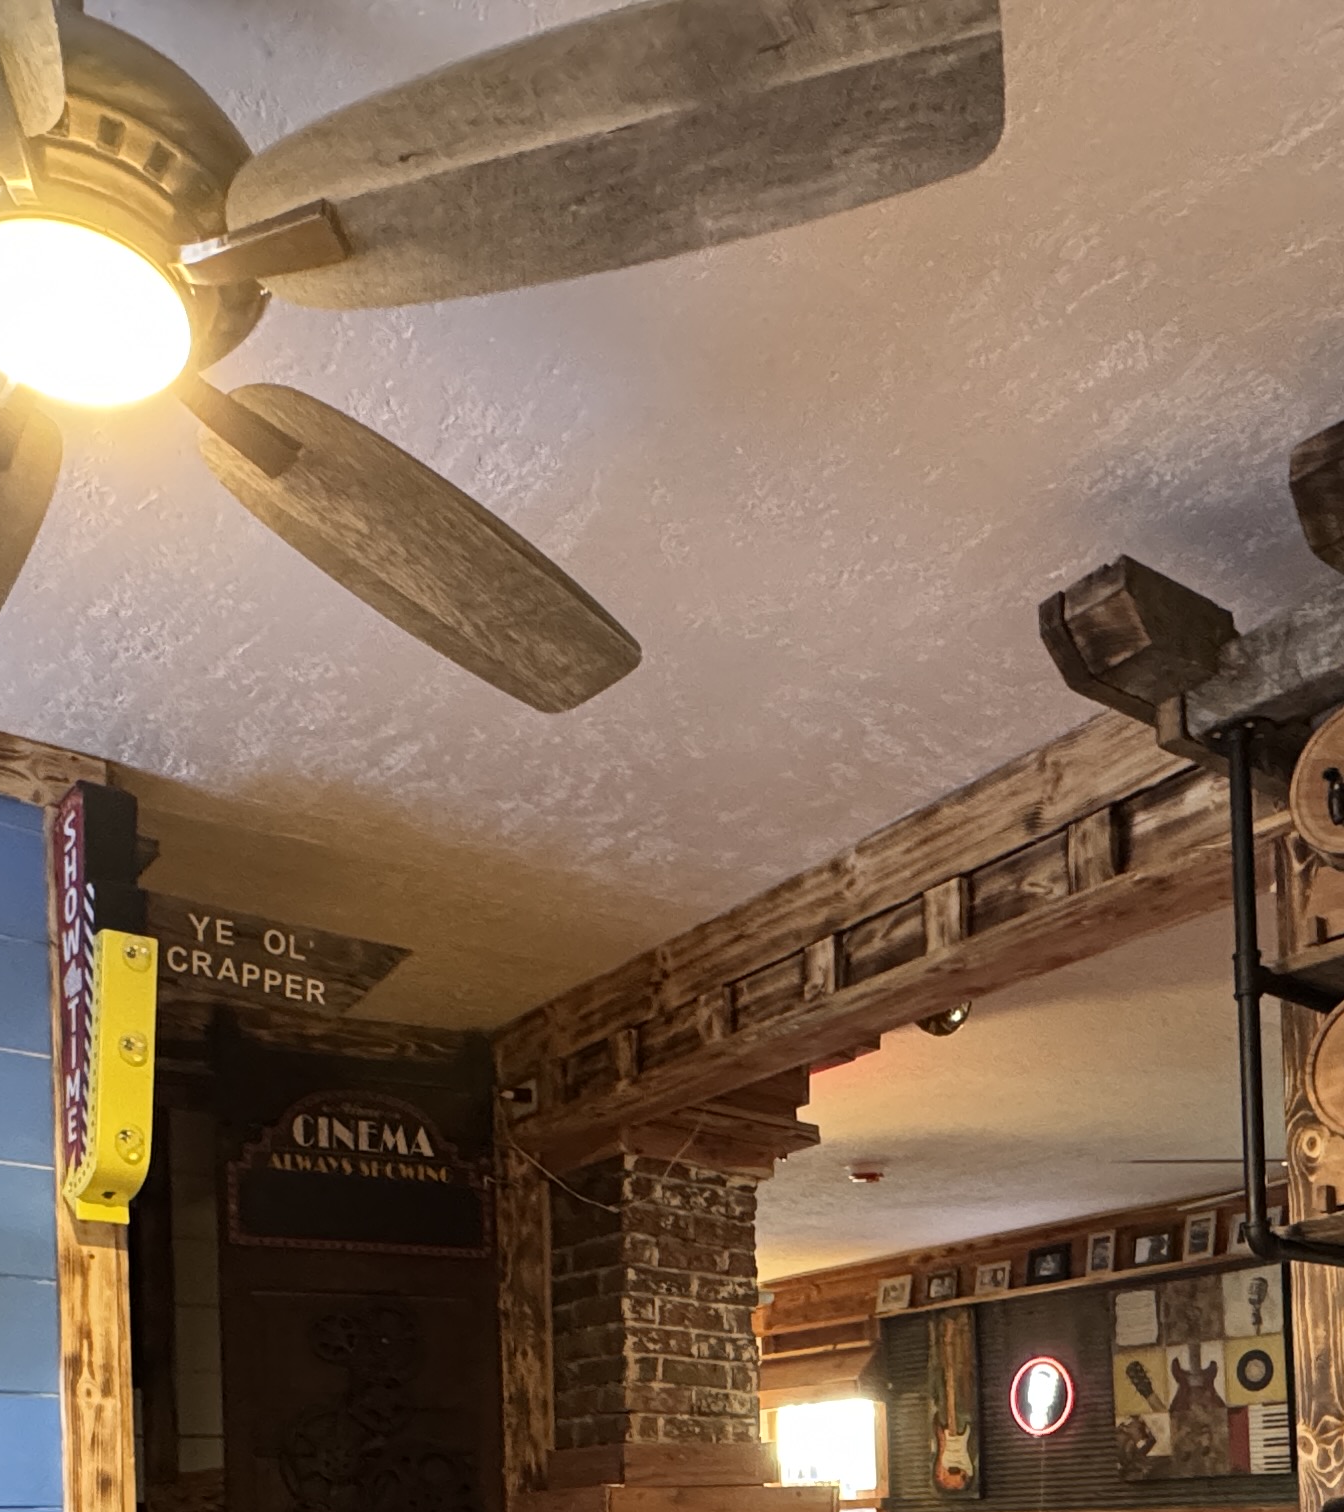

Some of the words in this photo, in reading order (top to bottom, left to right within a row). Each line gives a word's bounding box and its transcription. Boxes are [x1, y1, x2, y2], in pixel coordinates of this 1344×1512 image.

[62, 809, 81, 964] SHOW
[188, 912, 235, 947] YE
[263, 929, 315, 962] OL'
[166, 945, 326, 1006] CRAPPER
[65, 996, 81, 1144] TIME
[291, 1113, 436, 1158] CINEMA
[267, 1151, 354, 1177] ALWAYS
[359, 1159, 454, 1185] SHOWING
